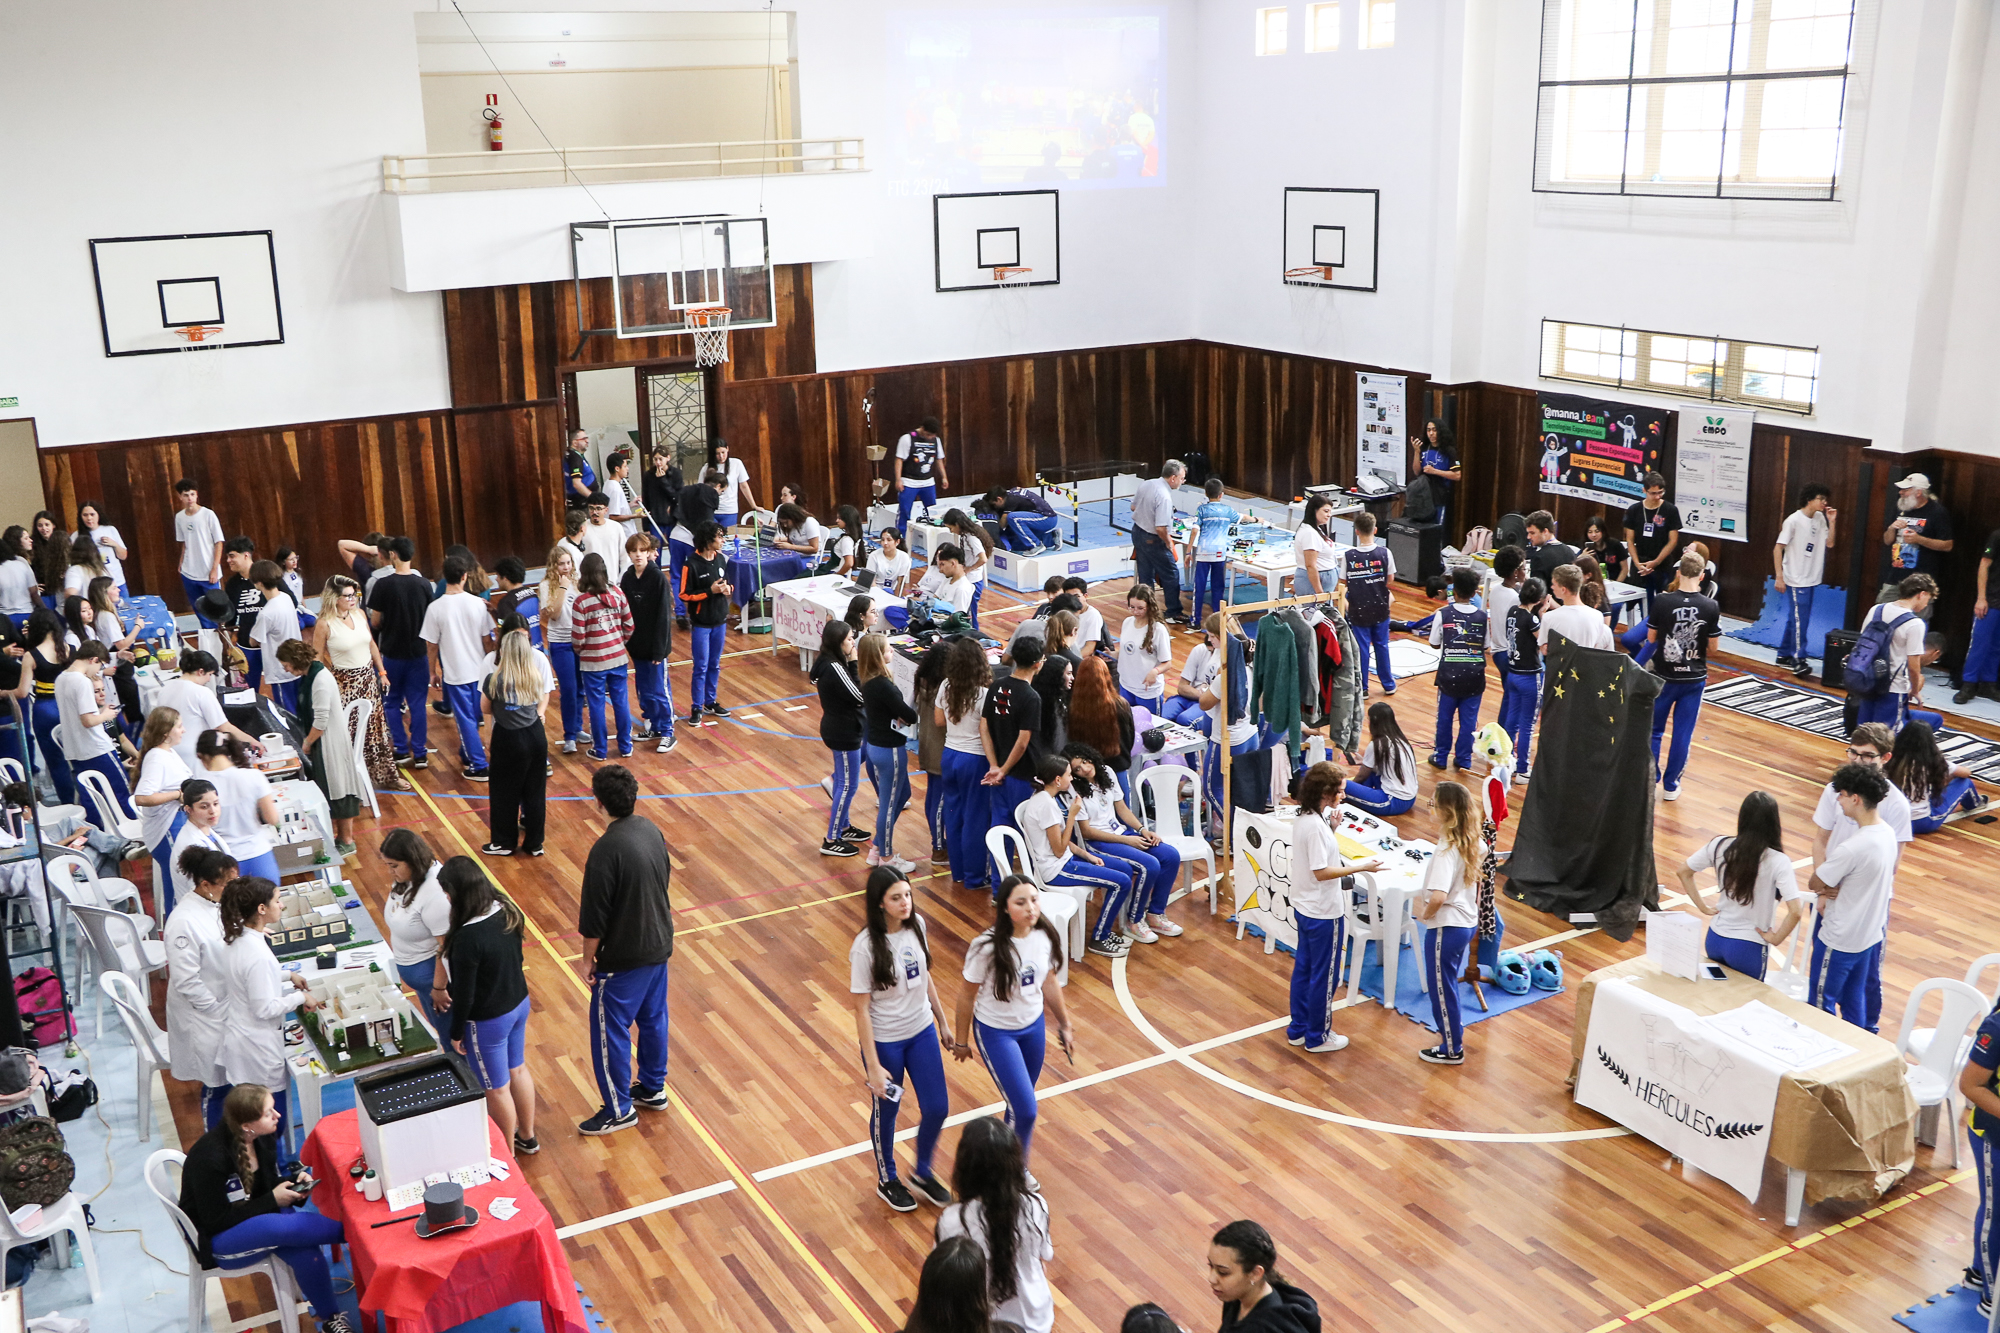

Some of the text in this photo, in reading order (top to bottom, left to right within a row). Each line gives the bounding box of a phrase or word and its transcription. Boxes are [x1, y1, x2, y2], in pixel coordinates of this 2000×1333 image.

[888, 178, 950, 197] FTC 23/24
[1544, 407, 1605, 425] @manna_team
[1545, 422, 1603, 437] Tecnologias Exponenciais
[1702, 425, 1727, 436] EMPO
[1589, 444, 1640, 460] Pessoas Exponenciais
[1573, 456, 1622, 472] Lugares Exponenciais
[1596, 476, 1614, 486] Futuros
[1672, 606, 1699, 622] TER
